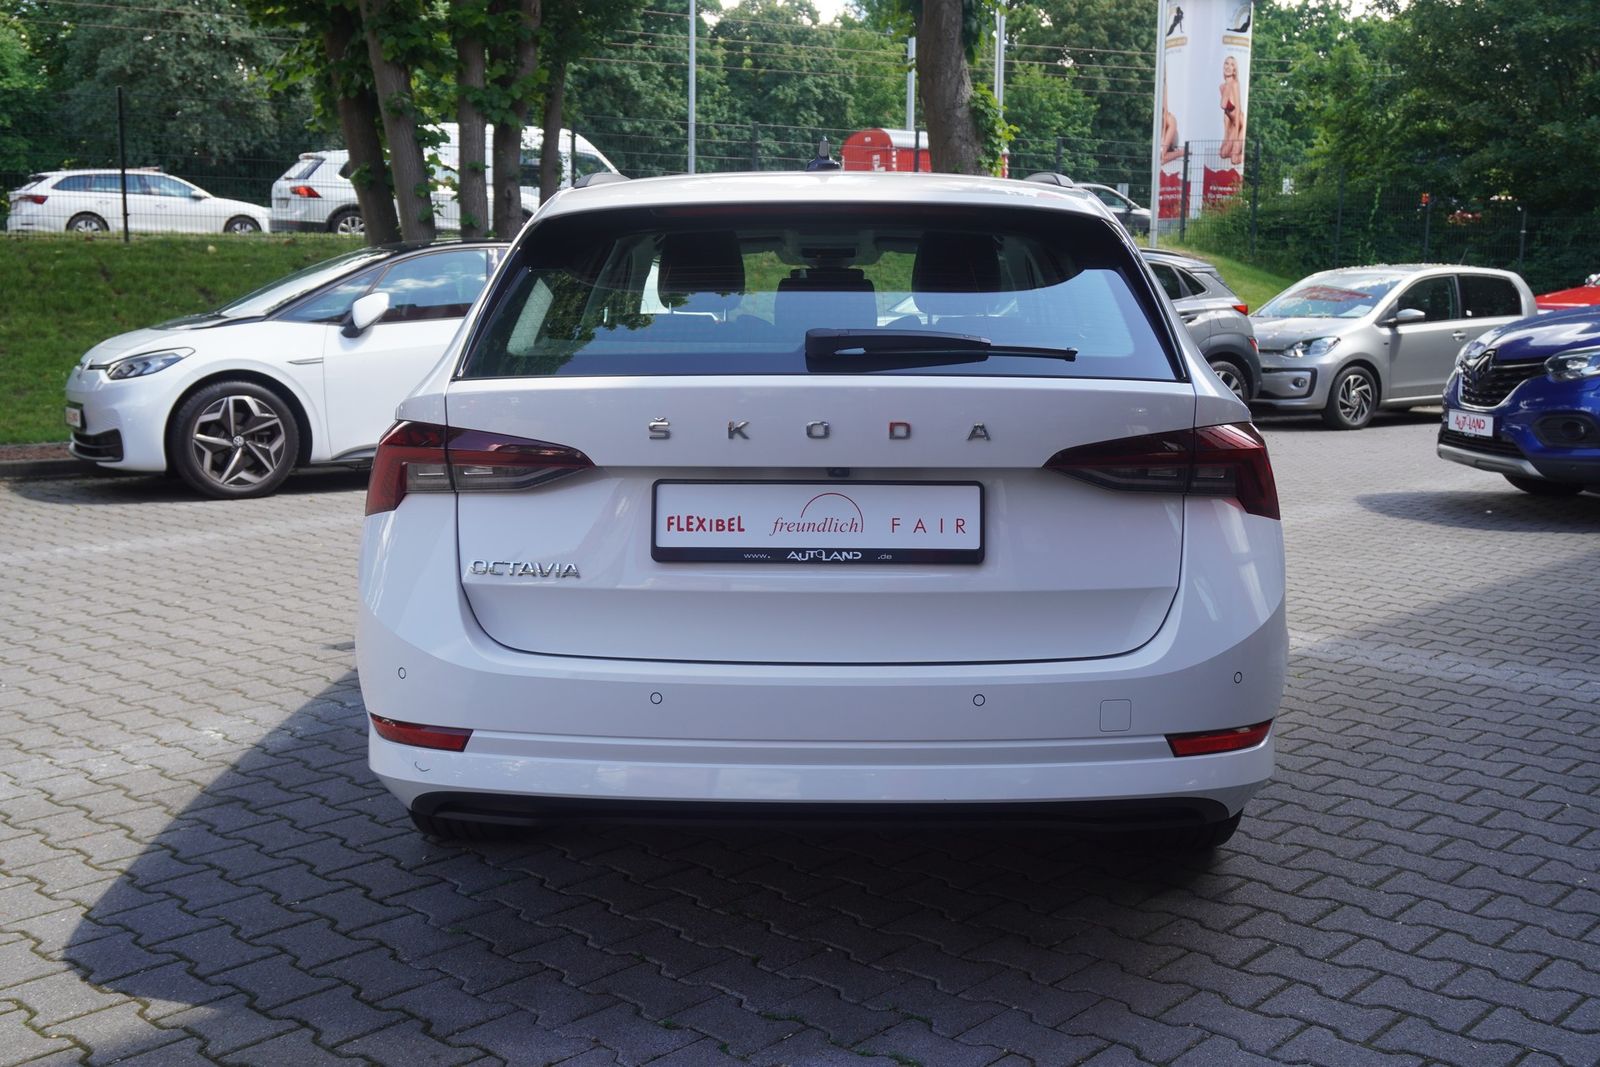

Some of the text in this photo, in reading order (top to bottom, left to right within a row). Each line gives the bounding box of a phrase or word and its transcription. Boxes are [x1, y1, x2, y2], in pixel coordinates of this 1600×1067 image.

[649, 417, 991, 441] ŠKODA
[667, 515, 967, 536] FLEXIBEL freundlich FAIR
[470, 559, 581, 579] OCTAVIA
